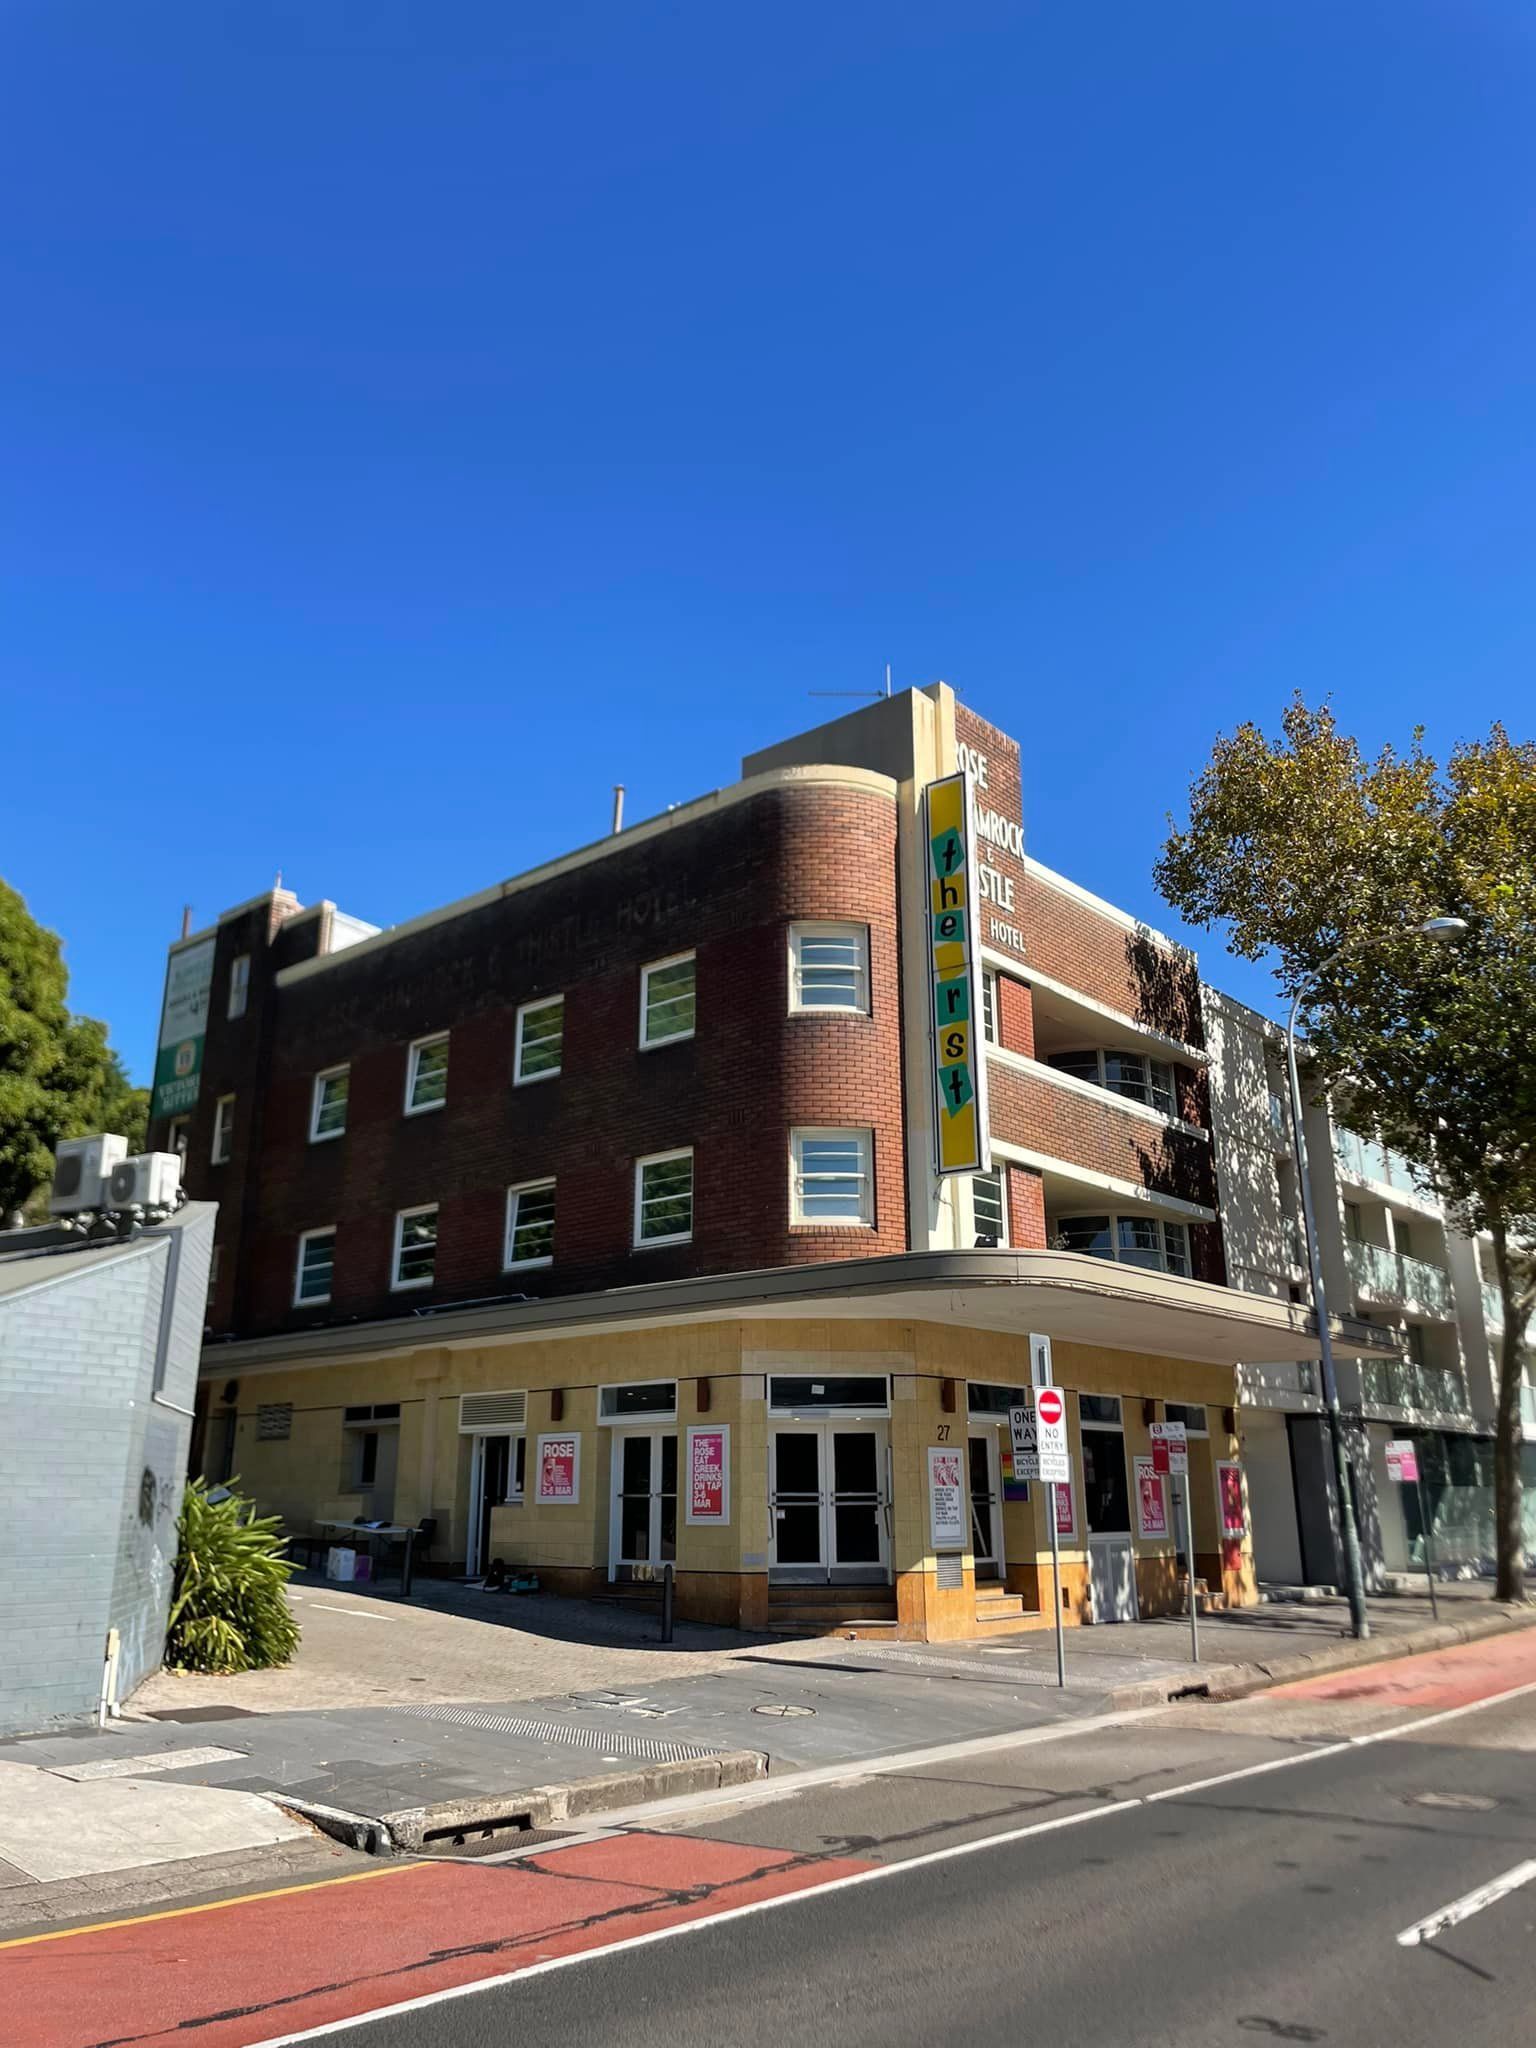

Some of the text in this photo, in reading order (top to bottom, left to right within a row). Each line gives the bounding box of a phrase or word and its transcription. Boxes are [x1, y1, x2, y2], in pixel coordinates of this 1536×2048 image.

[989, 916, 1026, 953] HOTEL
[1014, 1410, 1036, 1424] ONE
[937, 1425, 950, 1441] 27
[1045, 1428, 1059, 1439] NO
[694, 1439, 709, 1448] THE
[1041, 1440, 1063, 1451] ENTRY
[544, 1443, 574, 1458] ROSE
[694, 1447, 715, 1456] ROSE
[694, 1456, 709, 1465] EAT
[694, 1472, 721, 1482] DRINKS
[1138, 1465, 1160, 1480] ROS
[694, 1481, 721, 1490] ON TAP
[694, 1499, 711, 1508] MAR
